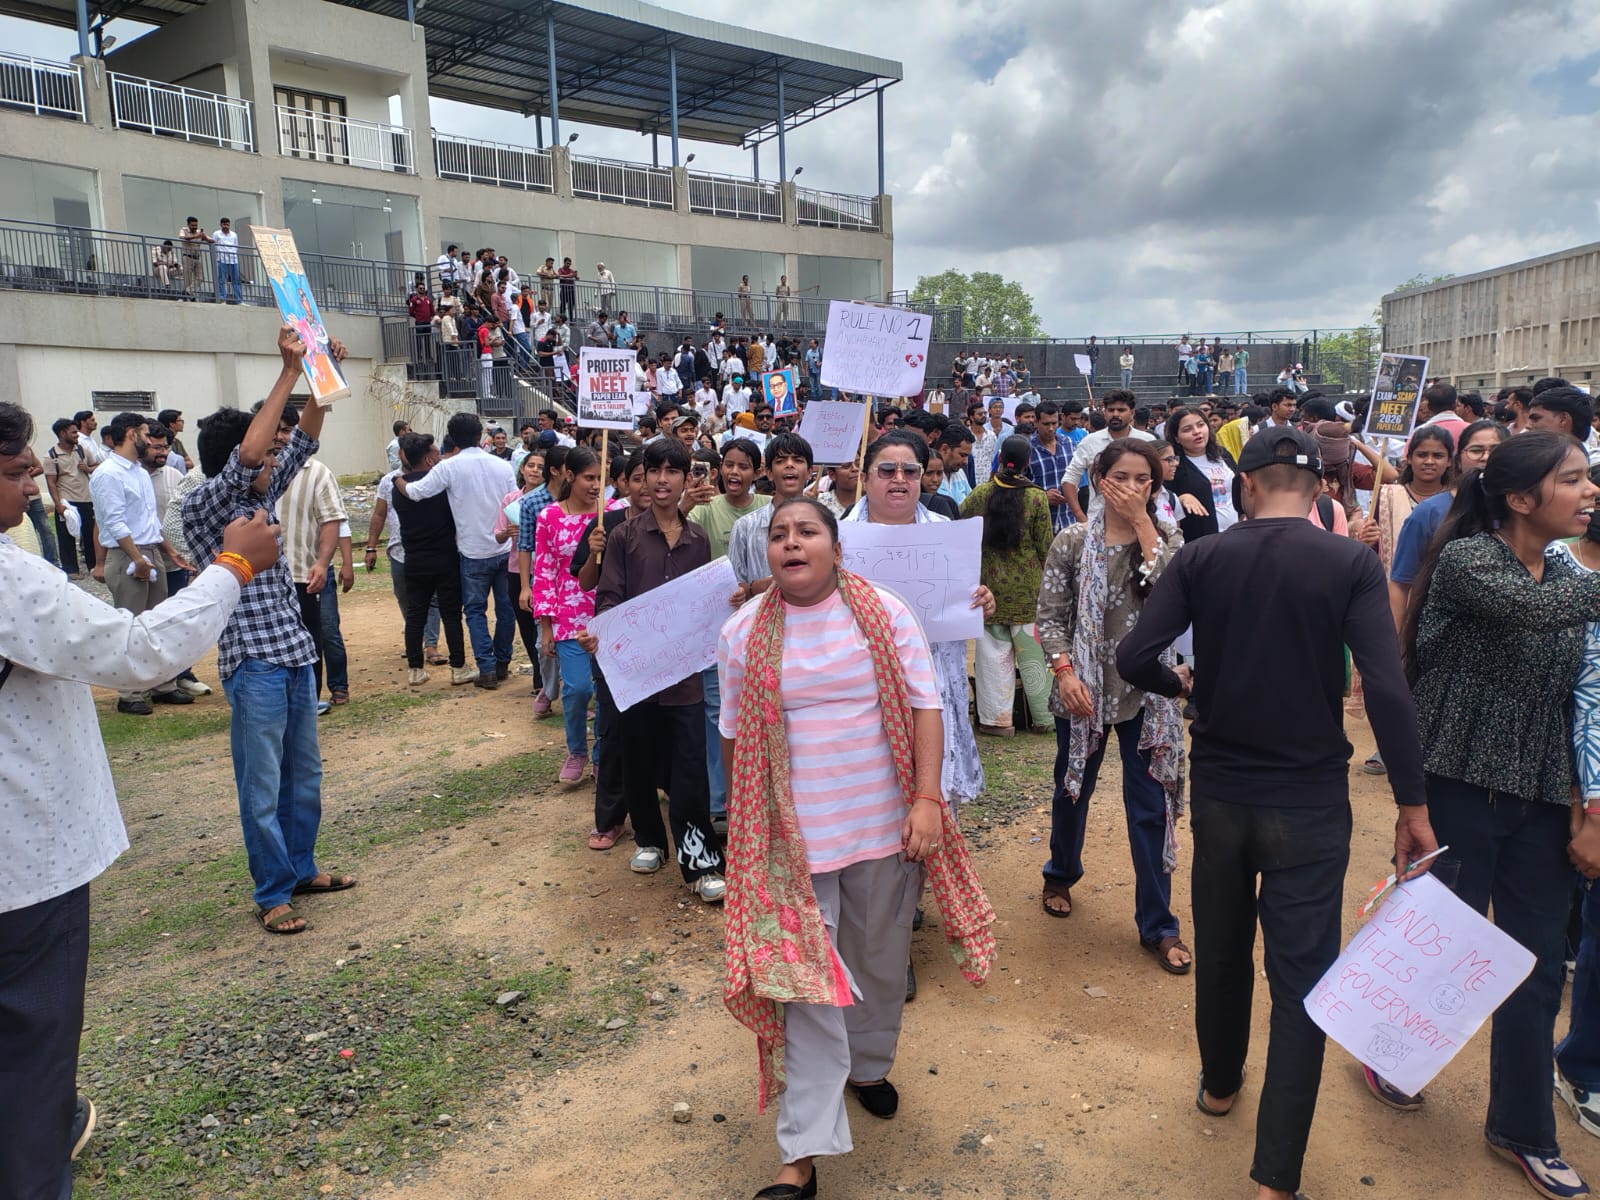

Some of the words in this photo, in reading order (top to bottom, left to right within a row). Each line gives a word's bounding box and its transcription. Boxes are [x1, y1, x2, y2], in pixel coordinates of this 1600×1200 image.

[840, 311, 876, 330] RULE
[880, 313, 903, 334] NO
[907, 318, 923, 341] 1
[587, 359, 630, 373] PROTEST
[590, 376, 627, 392] NEET
[593, 392, 611, 400] PAPER
[612, 392, 626, 400] LEAK
[1376, 392, 1393, 400] EXAM
[1381, 402, 1407, 415] NEET
[1379, 413, 1402, 424] 2026
[1357, 923, 1419, 984] THIS
[1451, 950, 1497, 992] ME
[1339, 962, 1457, 1050] GOVERNMENT
